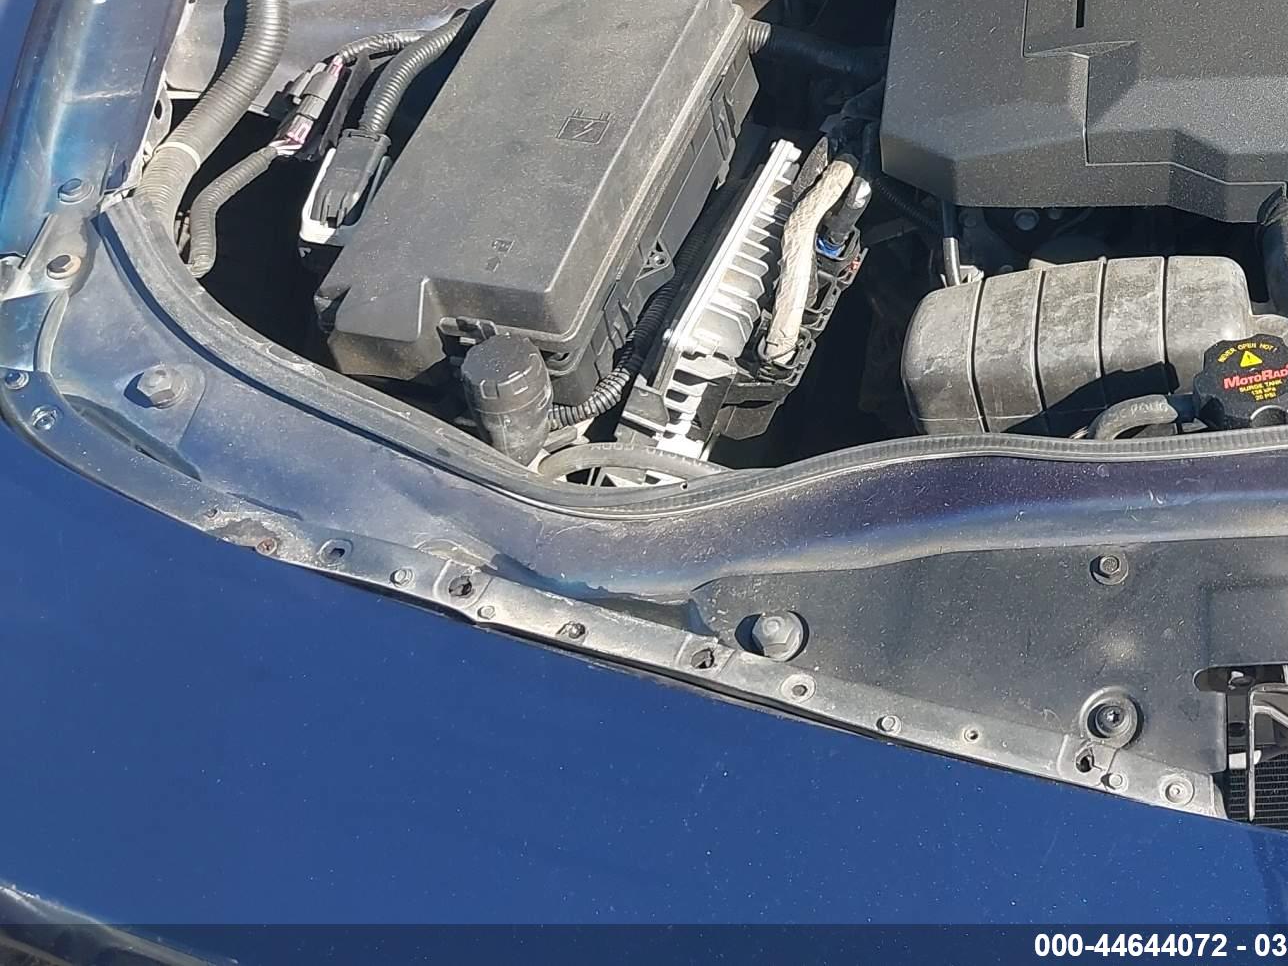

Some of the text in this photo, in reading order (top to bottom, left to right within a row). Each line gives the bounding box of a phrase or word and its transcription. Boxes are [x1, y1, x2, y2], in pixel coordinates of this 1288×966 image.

[1217, 347, 1237, 363] NEVER
[1237, 342, 1257, 351] OPEN
[1239, 379, 1283, 393] SURGE TANK
